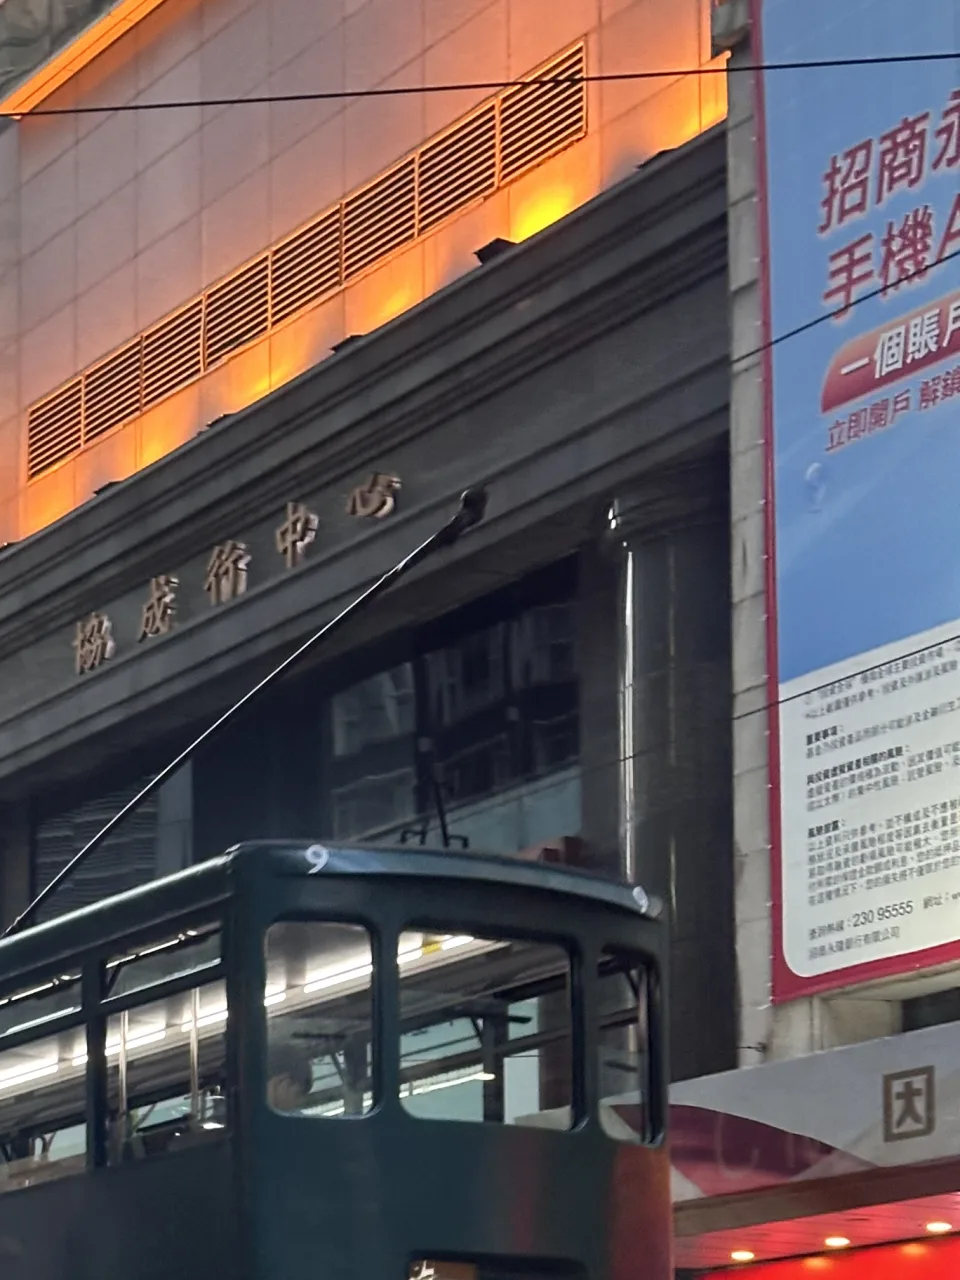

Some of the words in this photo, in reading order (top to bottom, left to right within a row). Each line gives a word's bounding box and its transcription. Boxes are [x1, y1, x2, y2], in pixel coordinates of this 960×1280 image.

[304, 843, 330, 874] 9
[632, 886, 650, 914] 9
[876, 900, 914, 921] 95555
